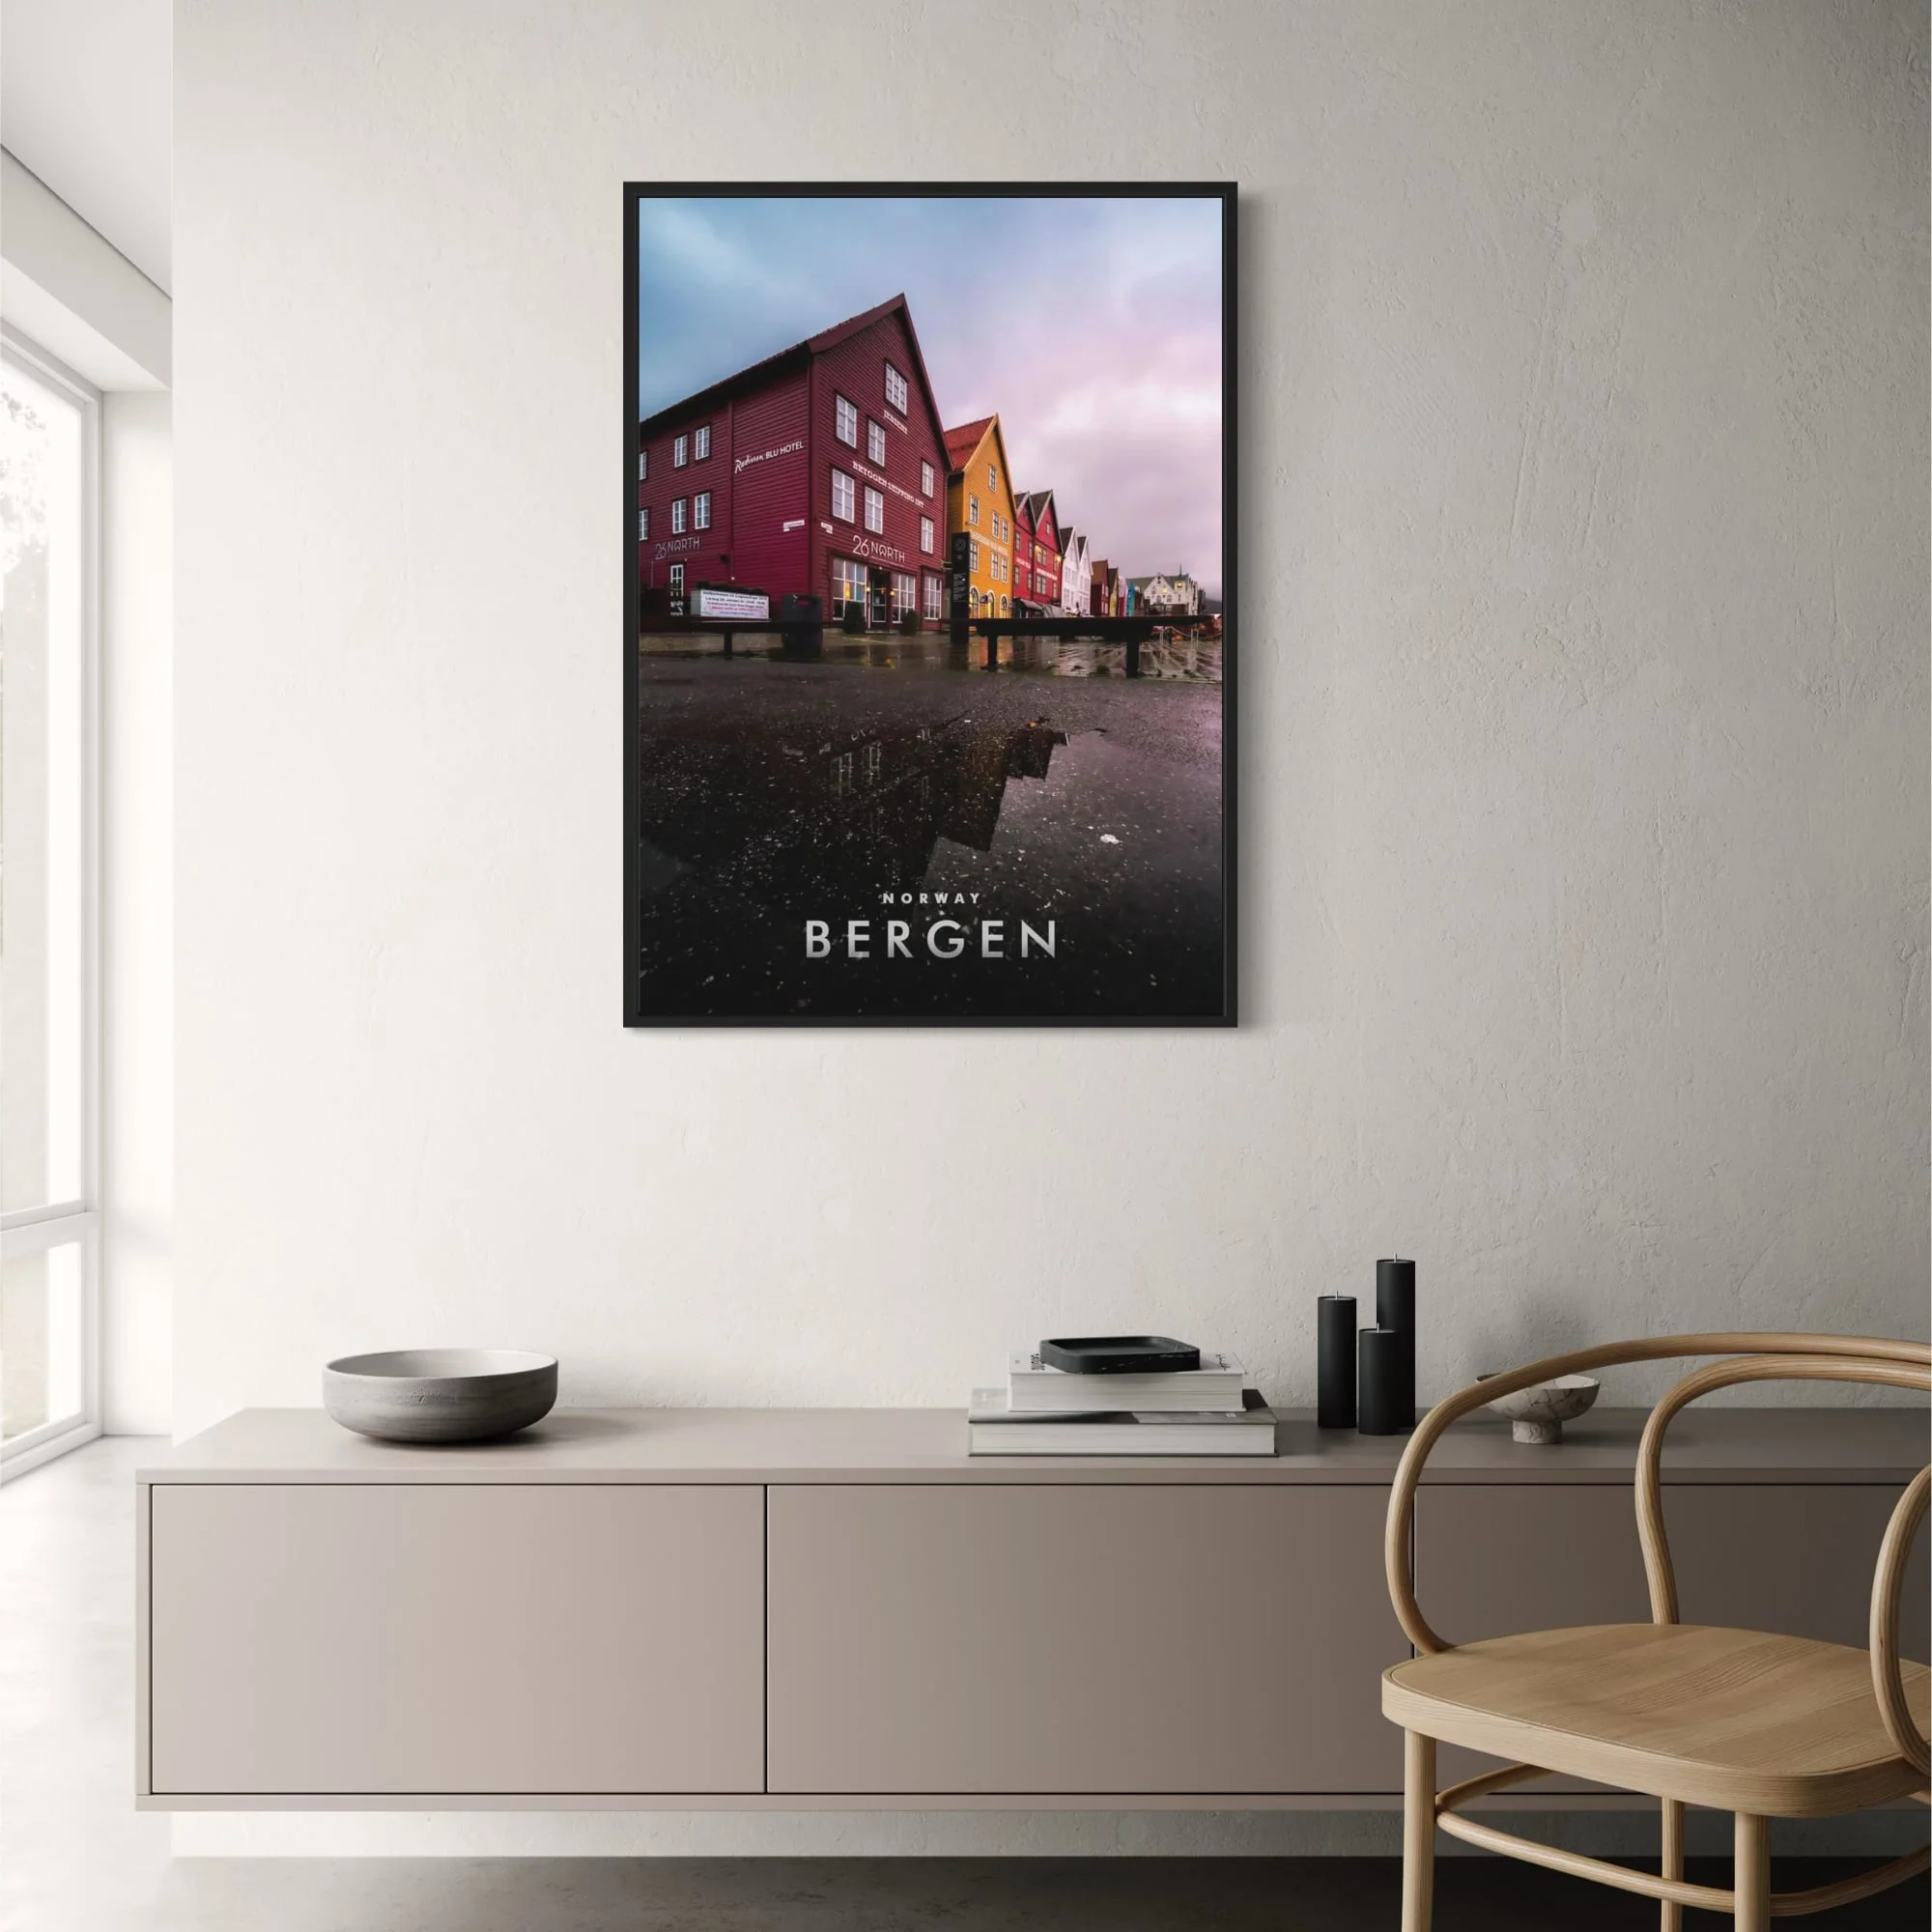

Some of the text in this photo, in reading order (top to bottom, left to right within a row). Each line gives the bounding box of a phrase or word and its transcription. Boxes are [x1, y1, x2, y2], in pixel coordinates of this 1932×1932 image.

[765, 448, 779, 460] BLU
[780, 440, 804, 455] HOTEL
[655, 536, 700, 560] 26 NORTH
[852, 534, 869, 556] 26
[870, 541, 905, 563] NORTH
[882, 892, 980, 904] NORWAY
[806, 919, 1056, 958] BERGEN
